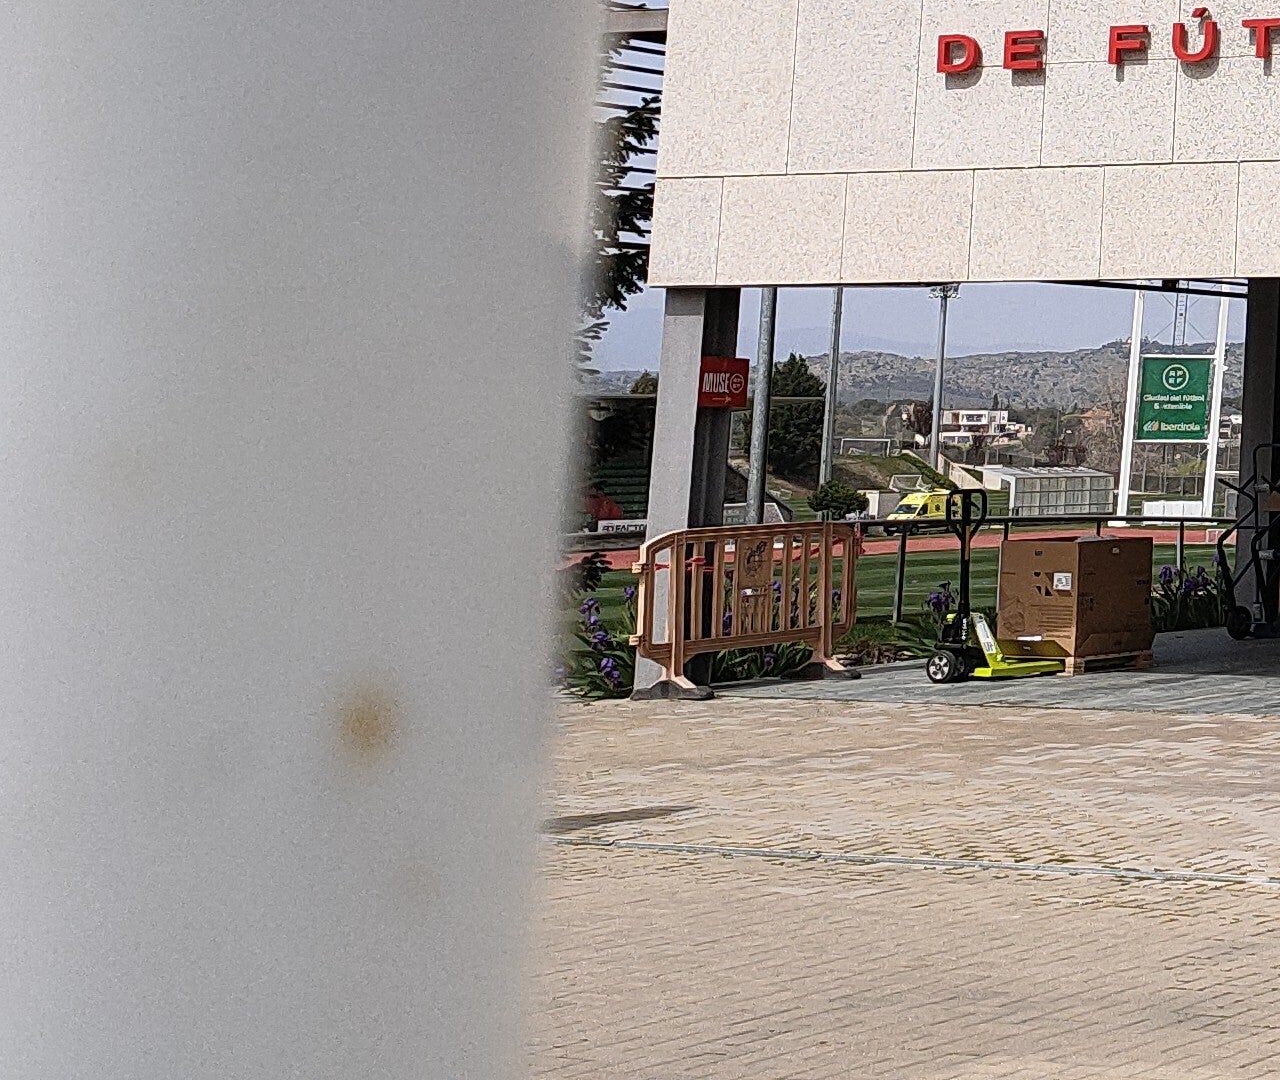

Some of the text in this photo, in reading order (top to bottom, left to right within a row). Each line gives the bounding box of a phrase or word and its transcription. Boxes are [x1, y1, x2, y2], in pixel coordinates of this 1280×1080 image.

[936, 29, 1047, 77] DE
[1143, 394, 1169, 402] Ciudad
[1170, 394, 1182, 402] del
